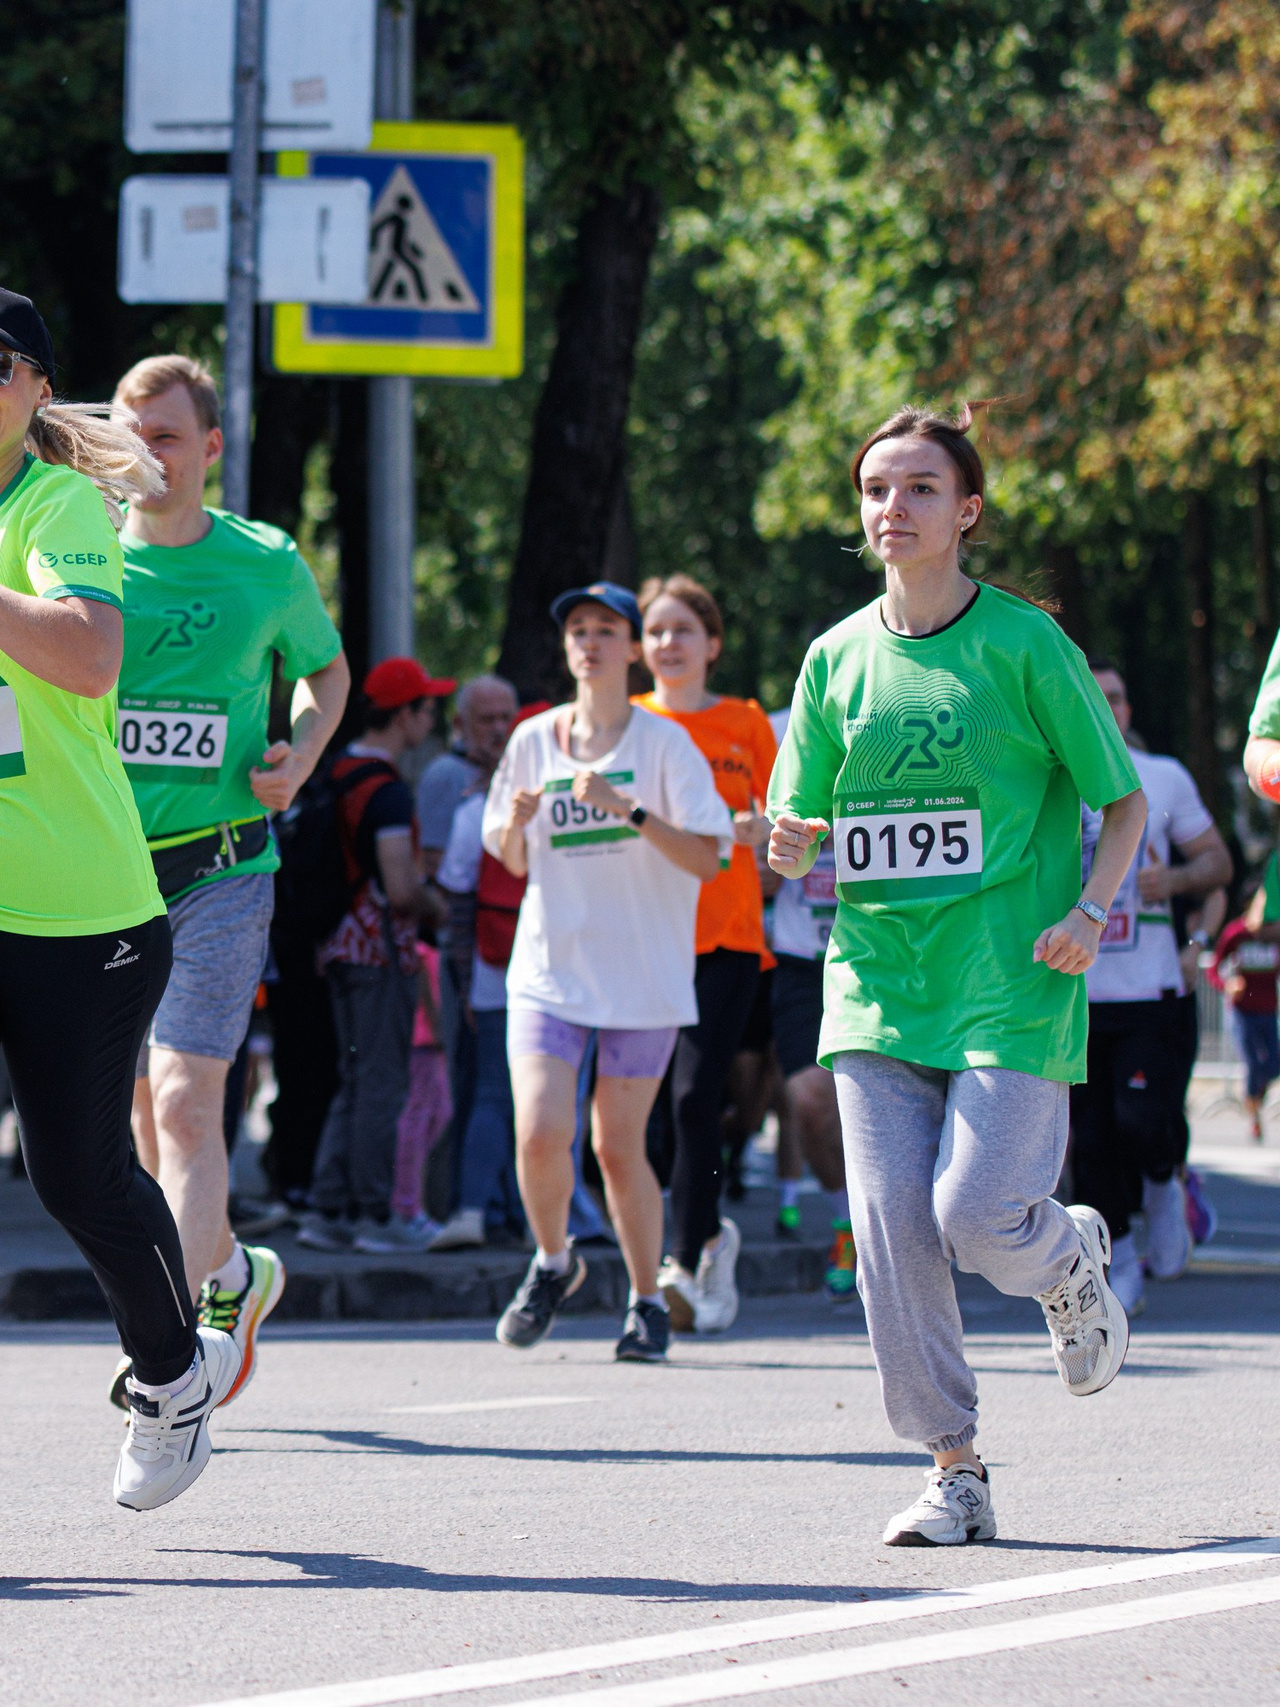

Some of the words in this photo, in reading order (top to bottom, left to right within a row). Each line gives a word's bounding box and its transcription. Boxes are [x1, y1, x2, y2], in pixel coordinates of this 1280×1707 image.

[62, 552, 108, 566] СБЕР
[121, 718, 216, 759] 0326
[855, 801, 875, 809] СБЕР
[924, 796, 965, 806] 01.06.2024
[551, 797, 622, 828] 05
[846, 819, 970, 872] 0195
[104, 953, 141, 970] DEMIX
